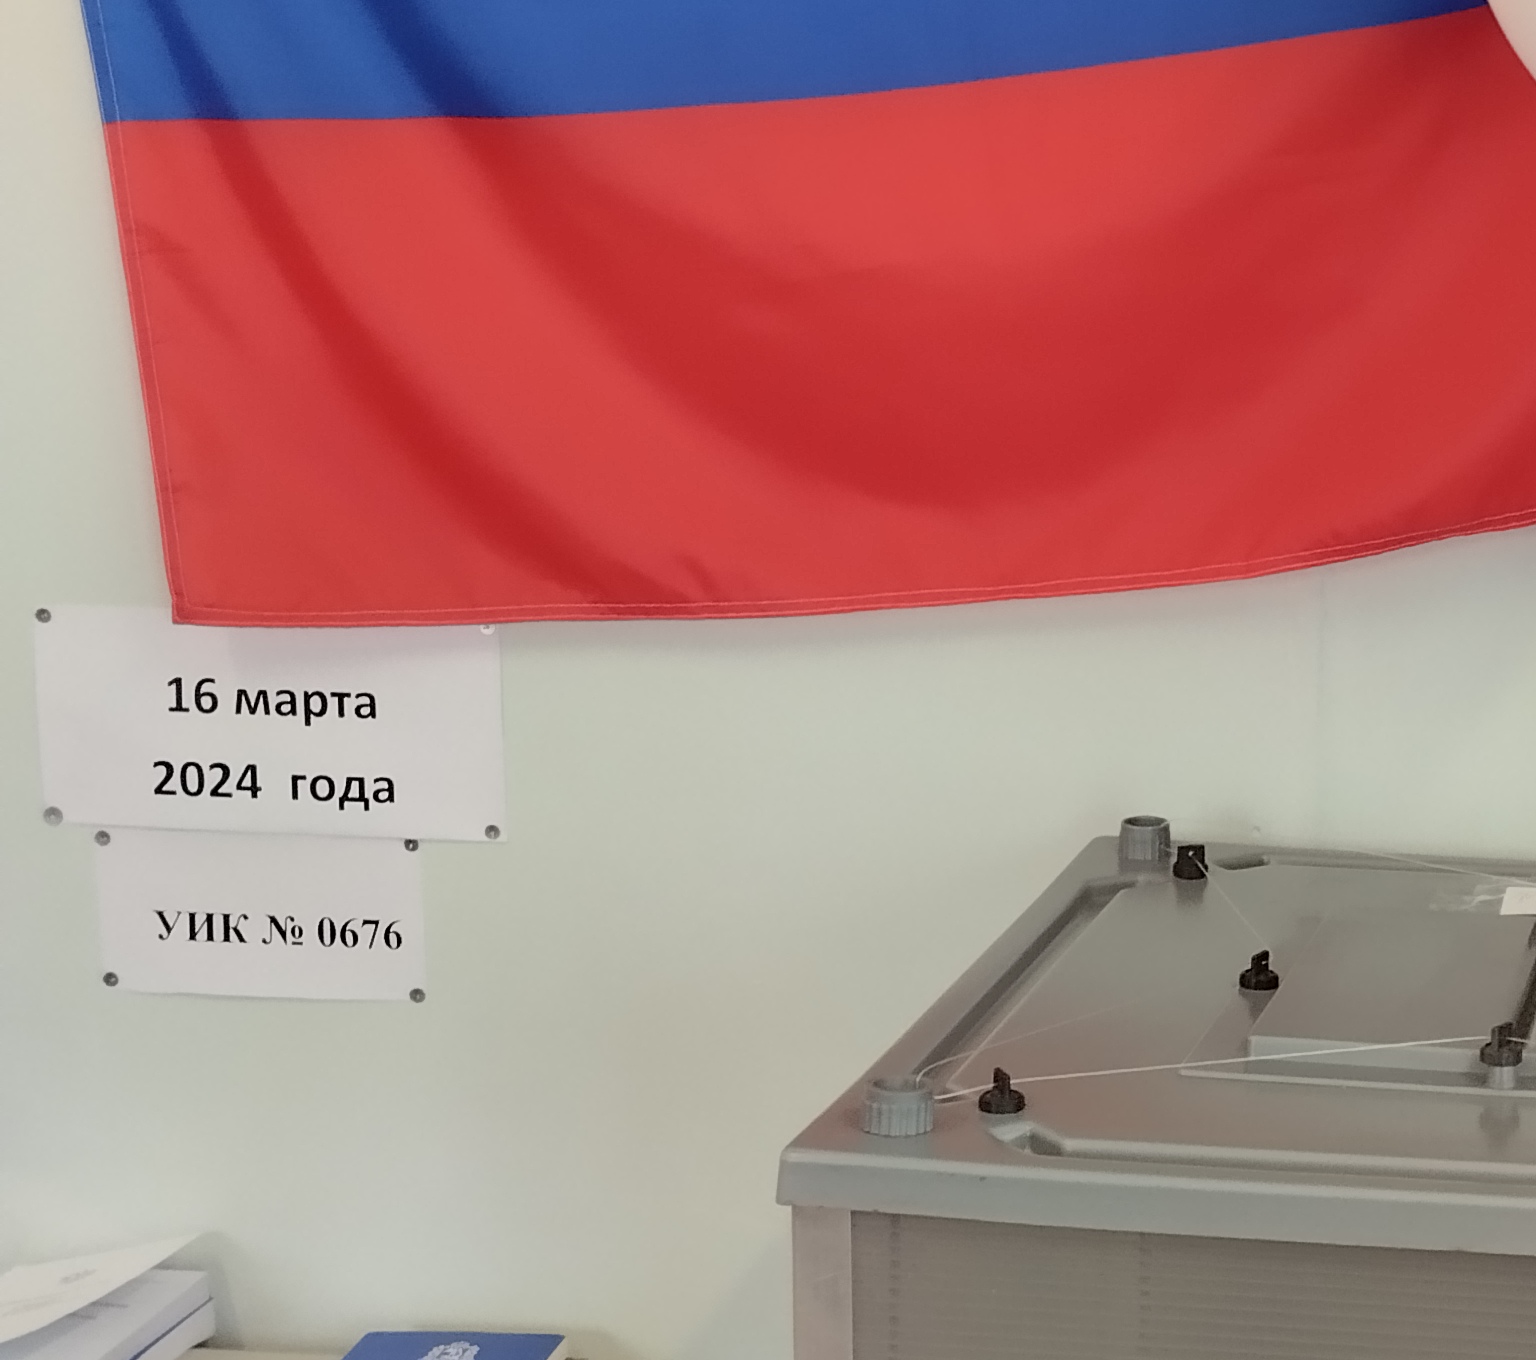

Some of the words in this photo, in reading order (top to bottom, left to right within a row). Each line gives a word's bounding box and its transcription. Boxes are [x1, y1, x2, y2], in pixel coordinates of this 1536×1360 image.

[166, 676, 219, 715] 16
[234, 687, 378, 727] марта
[152, 760, 263, 800] 2024
[290, 773, 396, 812] года
[153, 909, 250, 945] УИК
[261, 914, 304, 946] №
[317, 916, 403, 951] 0676
